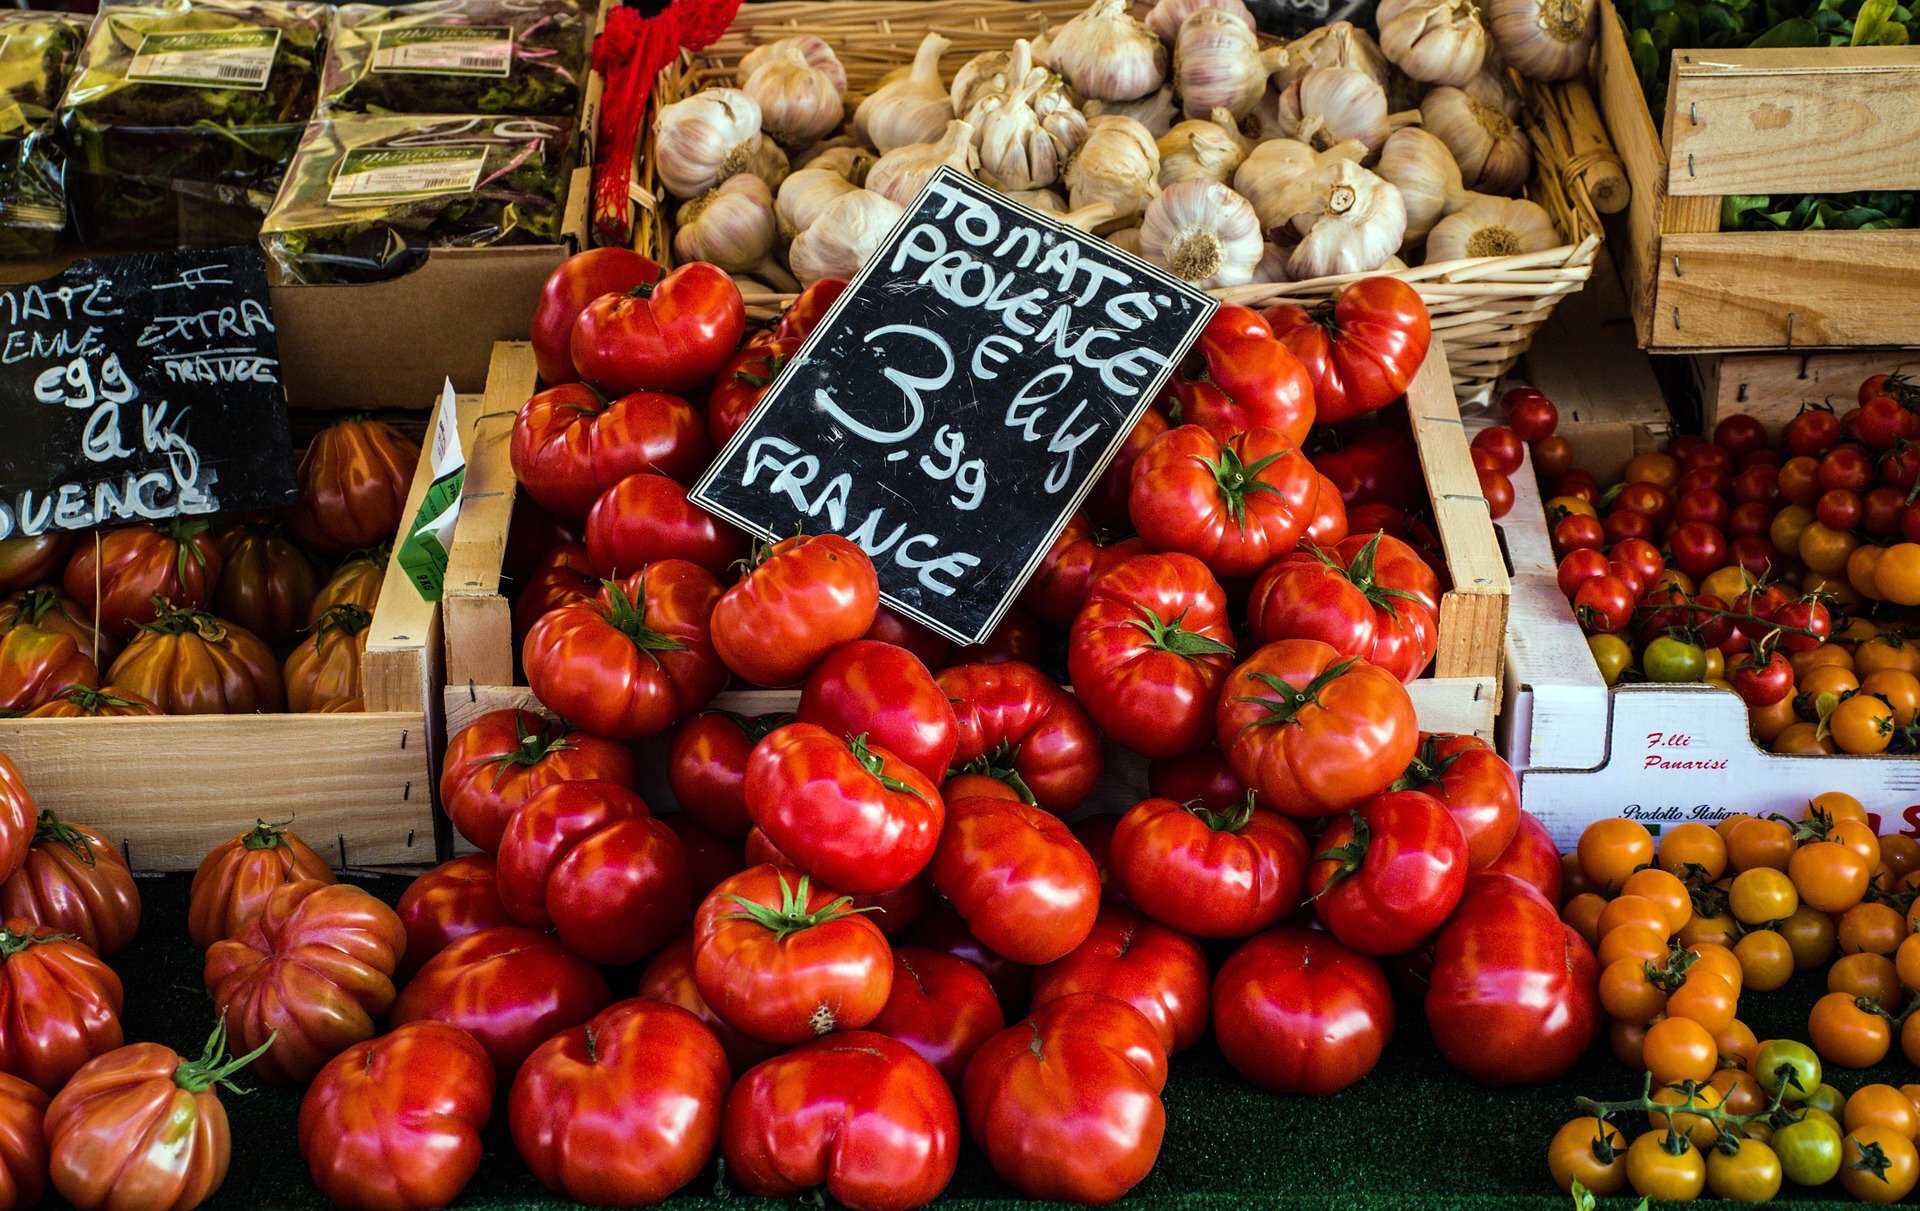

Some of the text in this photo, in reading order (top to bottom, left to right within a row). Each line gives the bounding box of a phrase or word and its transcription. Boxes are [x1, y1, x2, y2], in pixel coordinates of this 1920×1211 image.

[137, 299, 276, 348] EXTRA
[890, 224, 1171, 396] PROVENCE
[741, 435, 981, 596] FRANCE
[1646, 732, 1691, 749] F.lli
[1644, 754, 1729, 770] Panarisi
[1618, 804, 1683, 820] Prodotto
